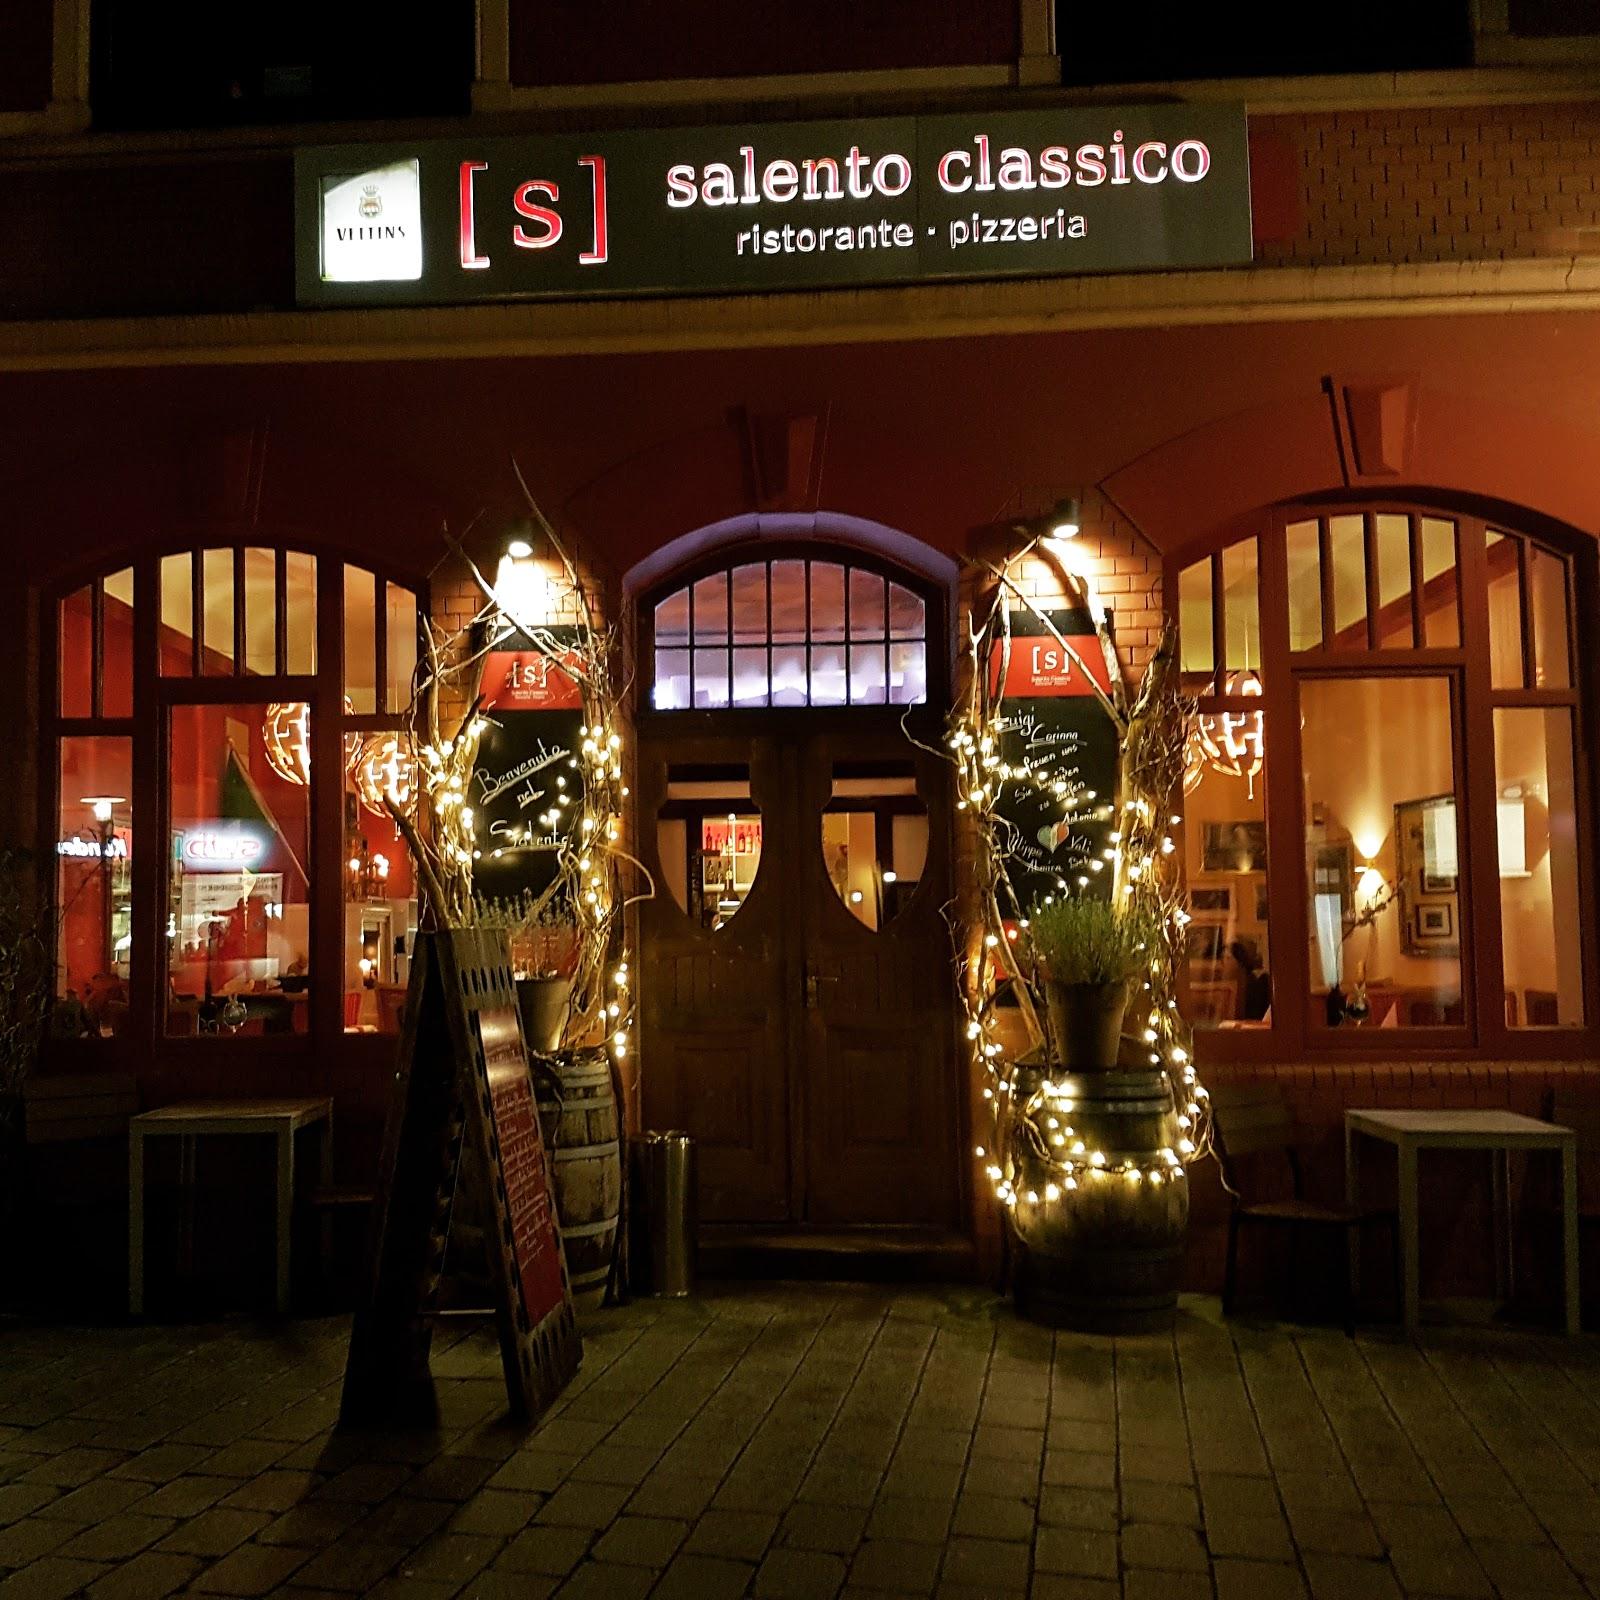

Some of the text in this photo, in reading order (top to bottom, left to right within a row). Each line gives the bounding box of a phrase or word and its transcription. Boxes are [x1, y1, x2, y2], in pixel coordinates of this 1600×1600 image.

[667, 130, 1210, 207] salento classico
[737, 208, 1088, 255] ristorante pizzeria
